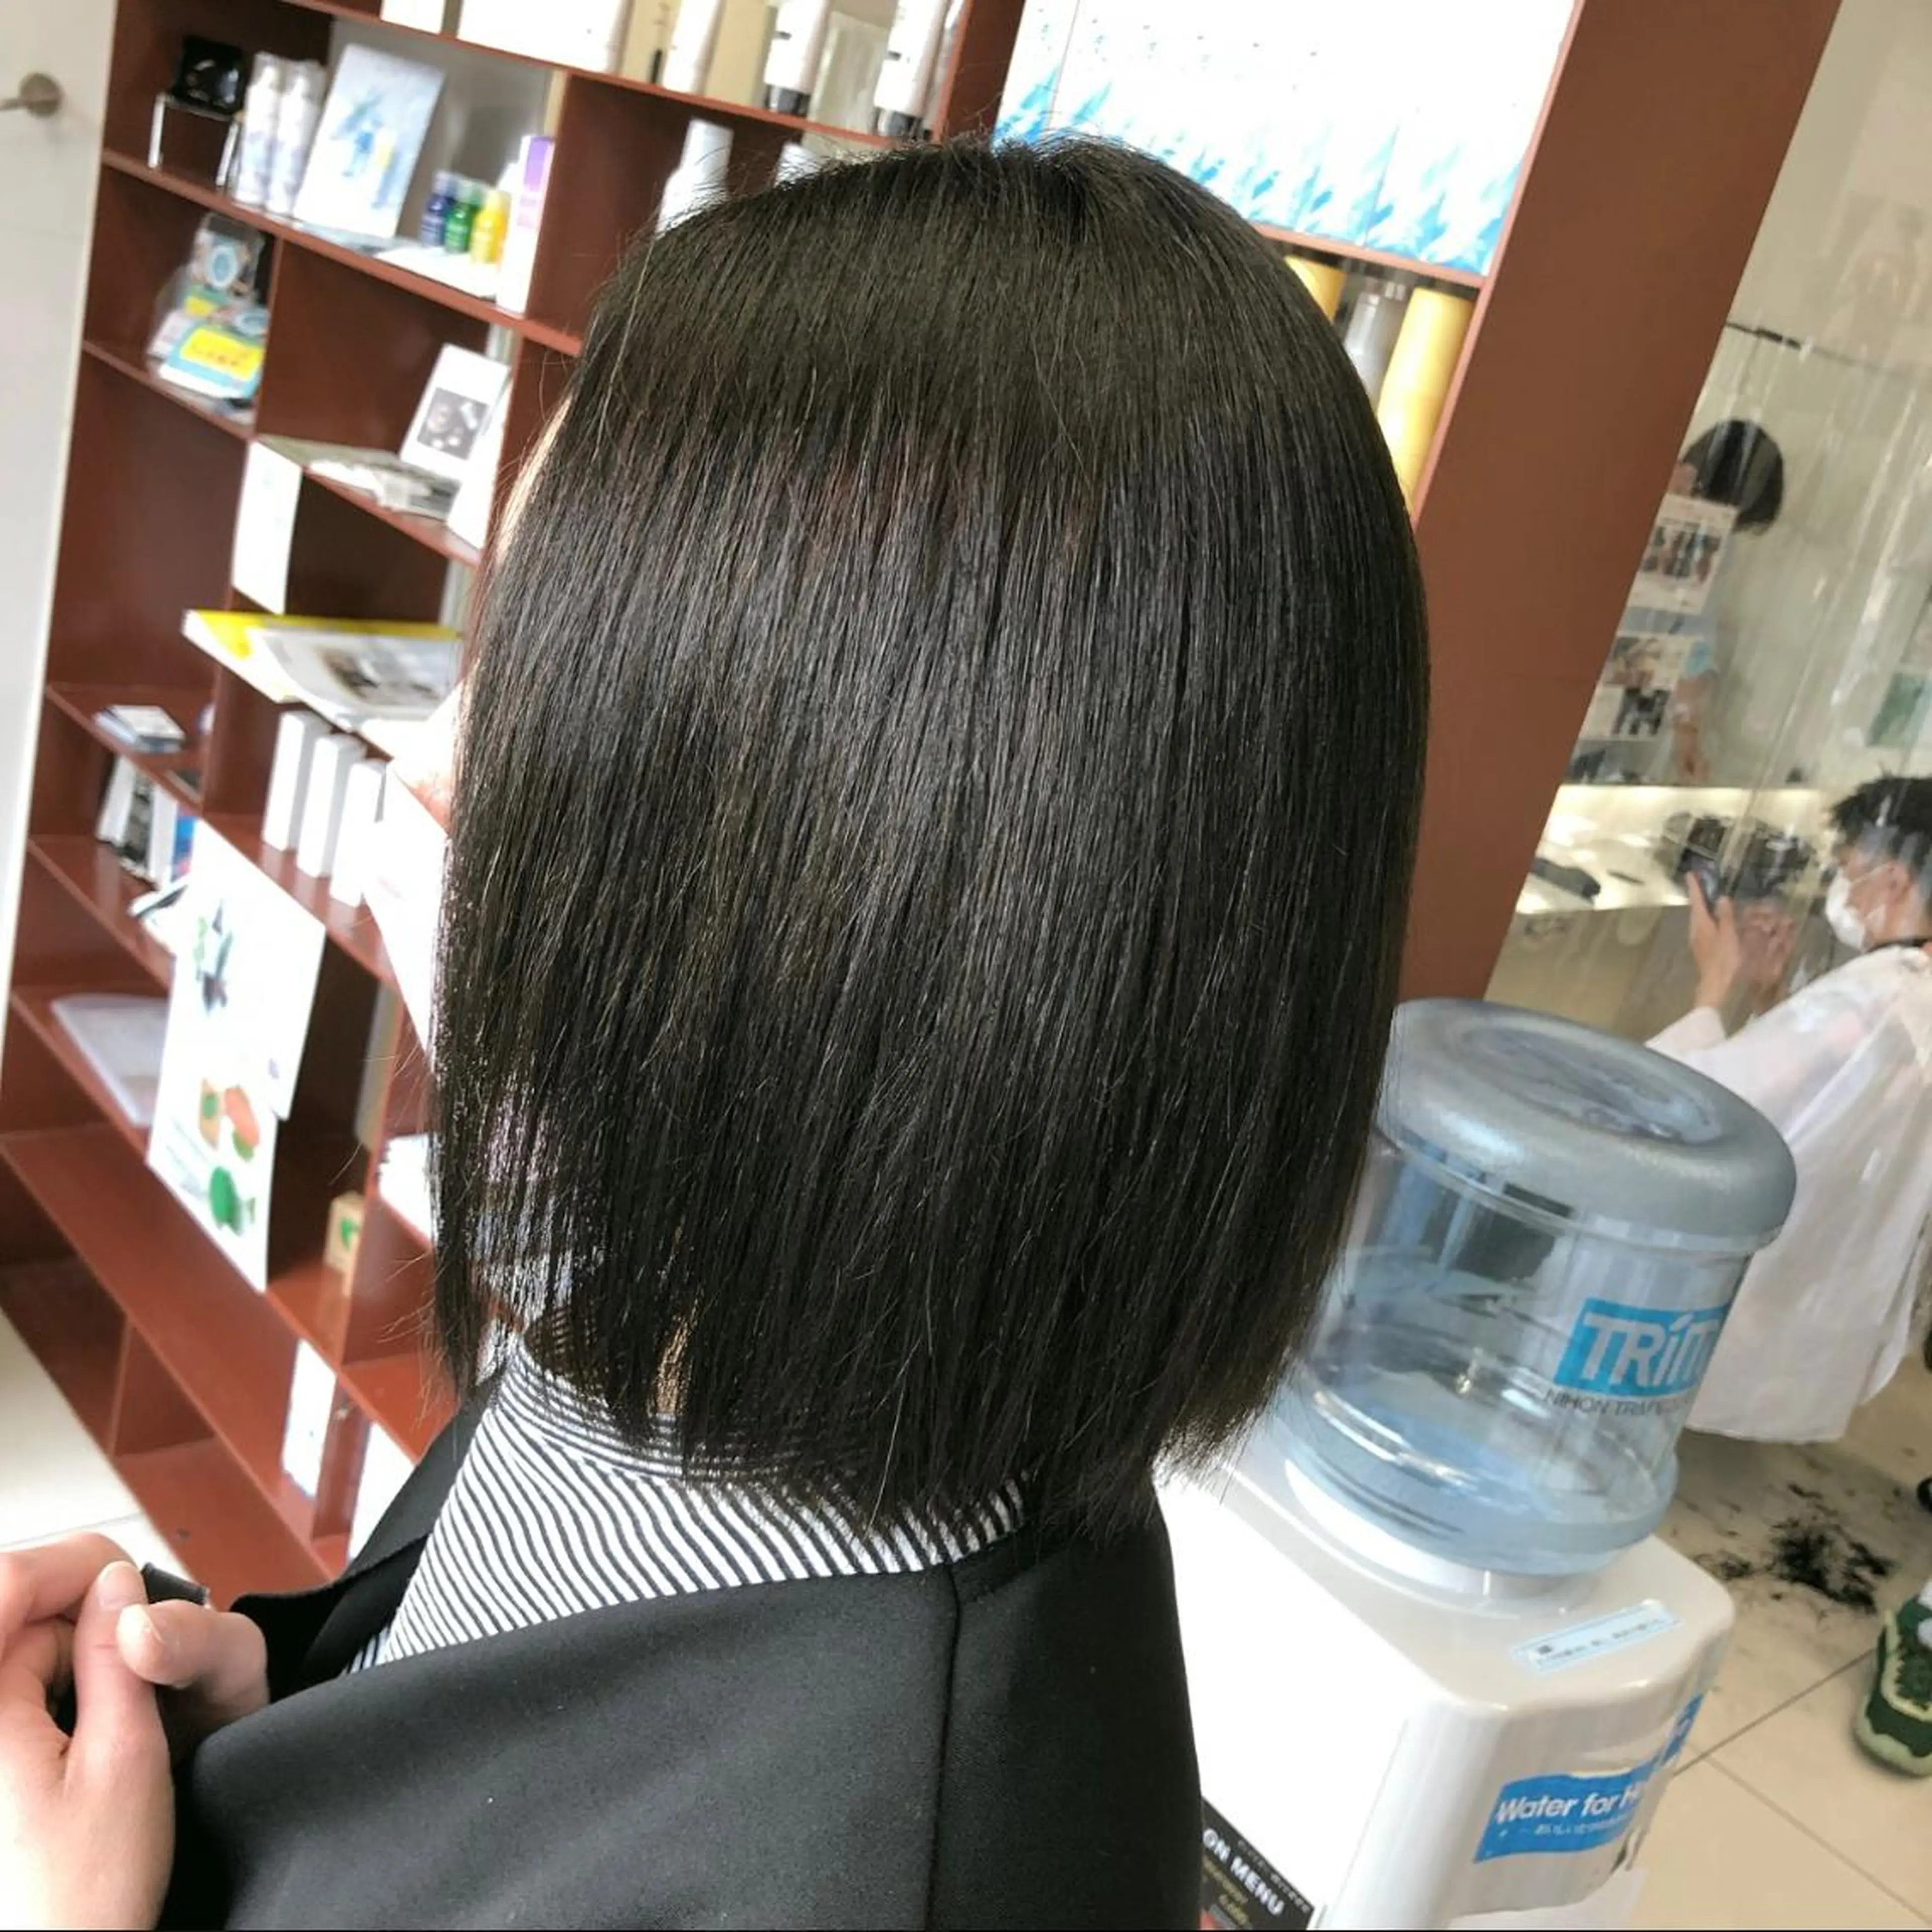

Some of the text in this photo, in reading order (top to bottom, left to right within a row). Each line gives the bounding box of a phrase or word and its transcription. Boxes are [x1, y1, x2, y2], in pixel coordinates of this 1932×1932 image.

[1496, 1795, 1579, 1824] Water
[1581, 1792, 1620, 1817] for
[1230, 1856, 1285, 1915] MENU
